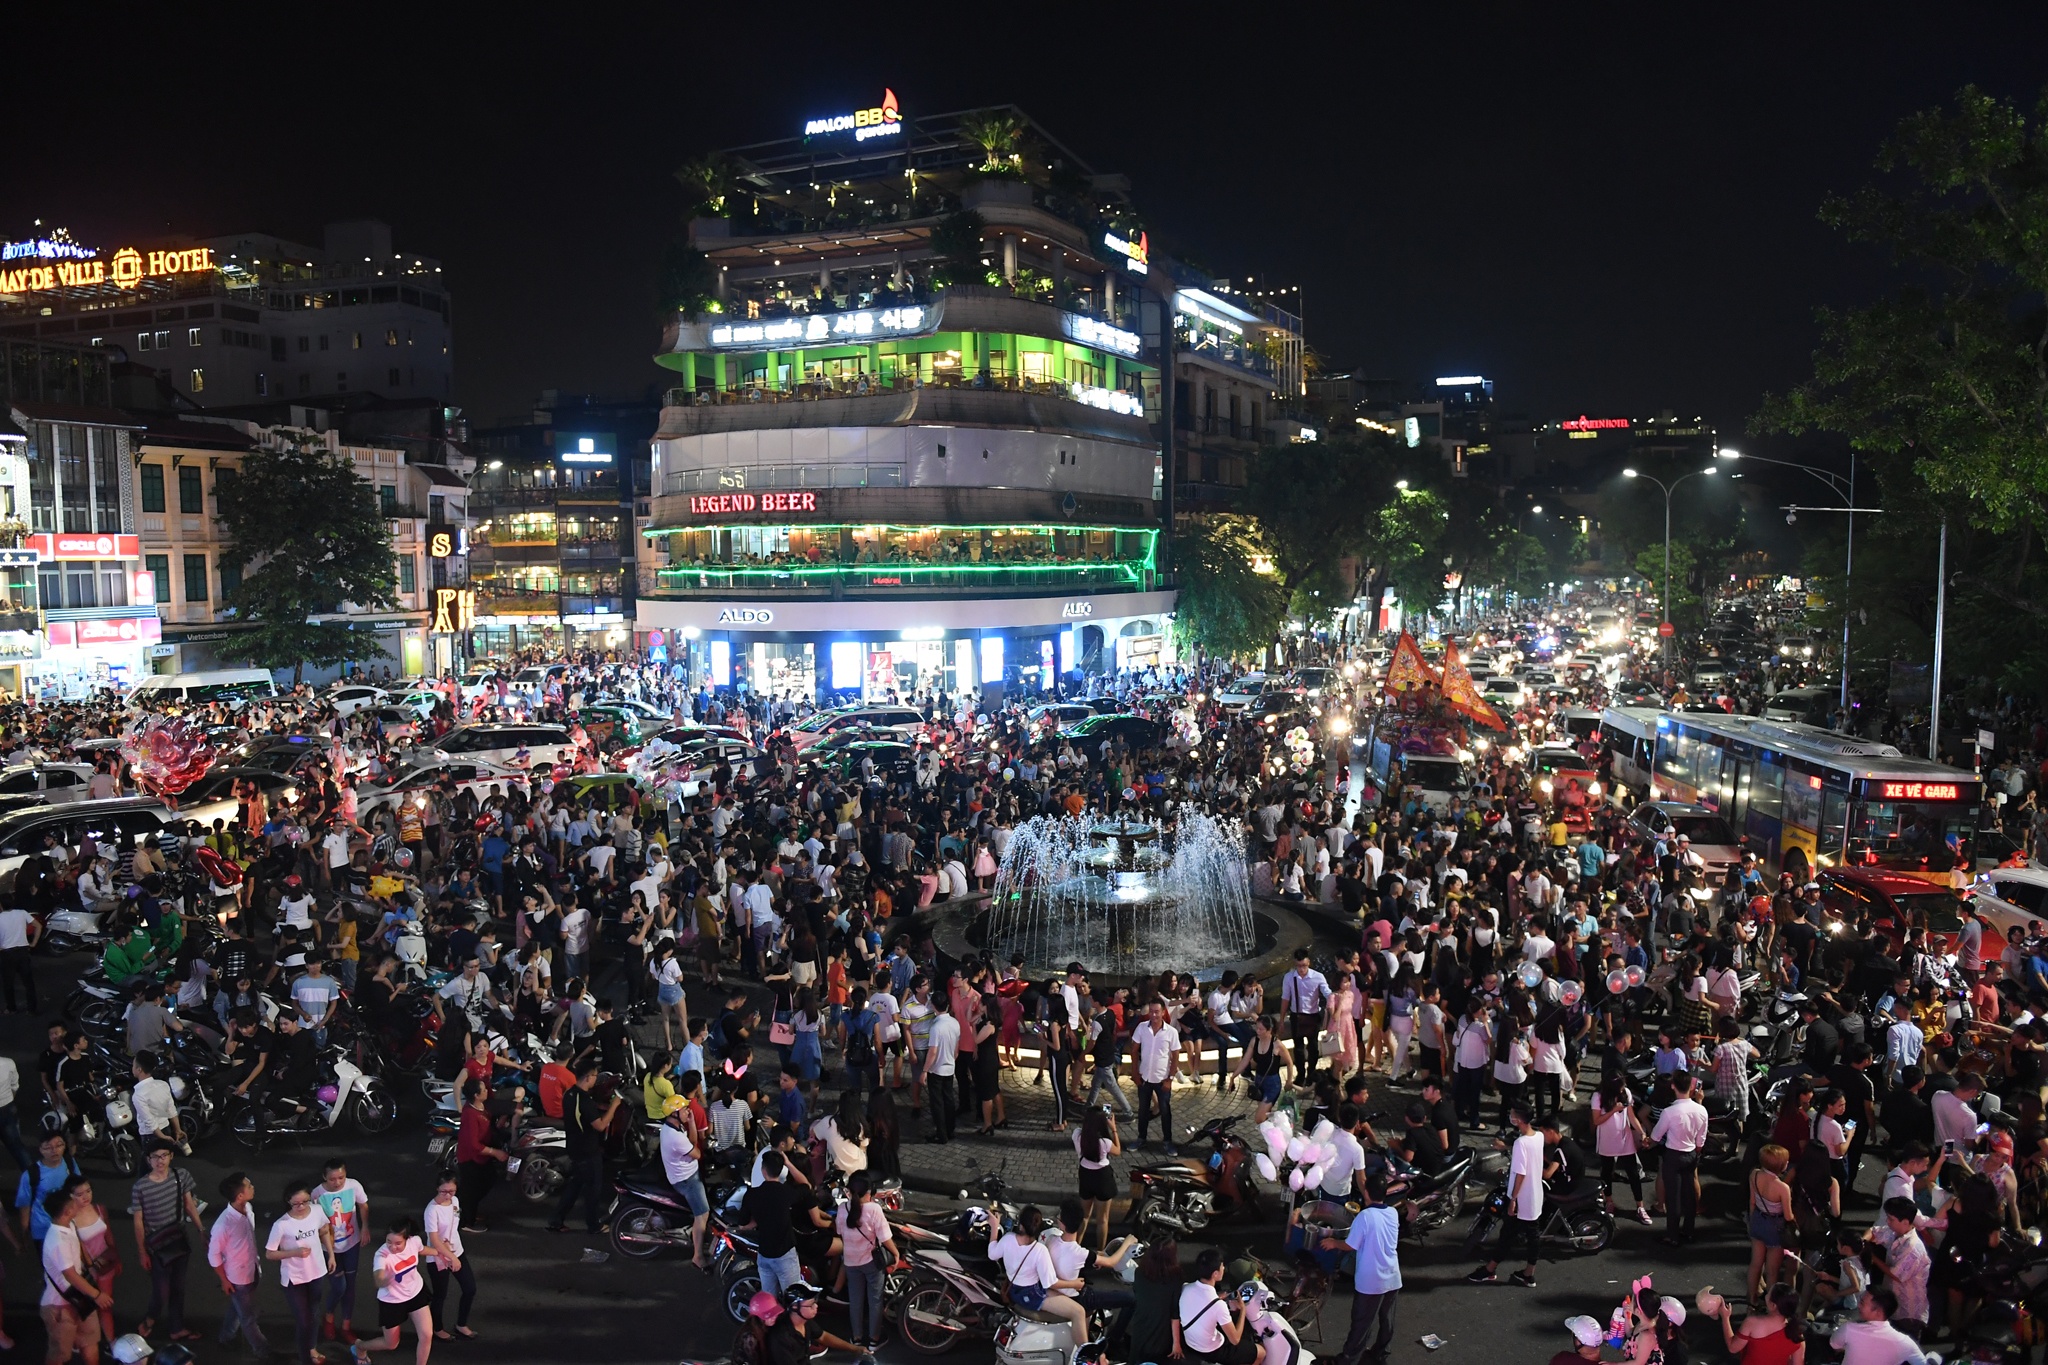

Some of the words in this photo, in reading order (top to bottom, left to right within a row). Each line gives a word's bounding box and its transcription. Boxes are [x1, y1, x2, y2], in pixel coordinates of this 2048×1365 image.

[805, 115, 855, 135] AVALON
[855, 124, 900, 141] garden
[29, 266, 55, 290] DE
[56, 261, 104, 286] VILLE
[148, 248, 213, 276] HOTEL
[1605, 418, 1630, 428] HOTEL
[690, 494, 756, 514] LEGEND
[761, 492, 817, 511] BEER
[59, 540, 96, 551] CIRCLE
[719, 609, 773, 623] ALDO
[374, 621, 407, 629] Vietcombank
[187, 632, 229, 641] Vietcombank
[1886, 784, 1904, 797] XE
[1924, 785, 1956, 798] GARA
